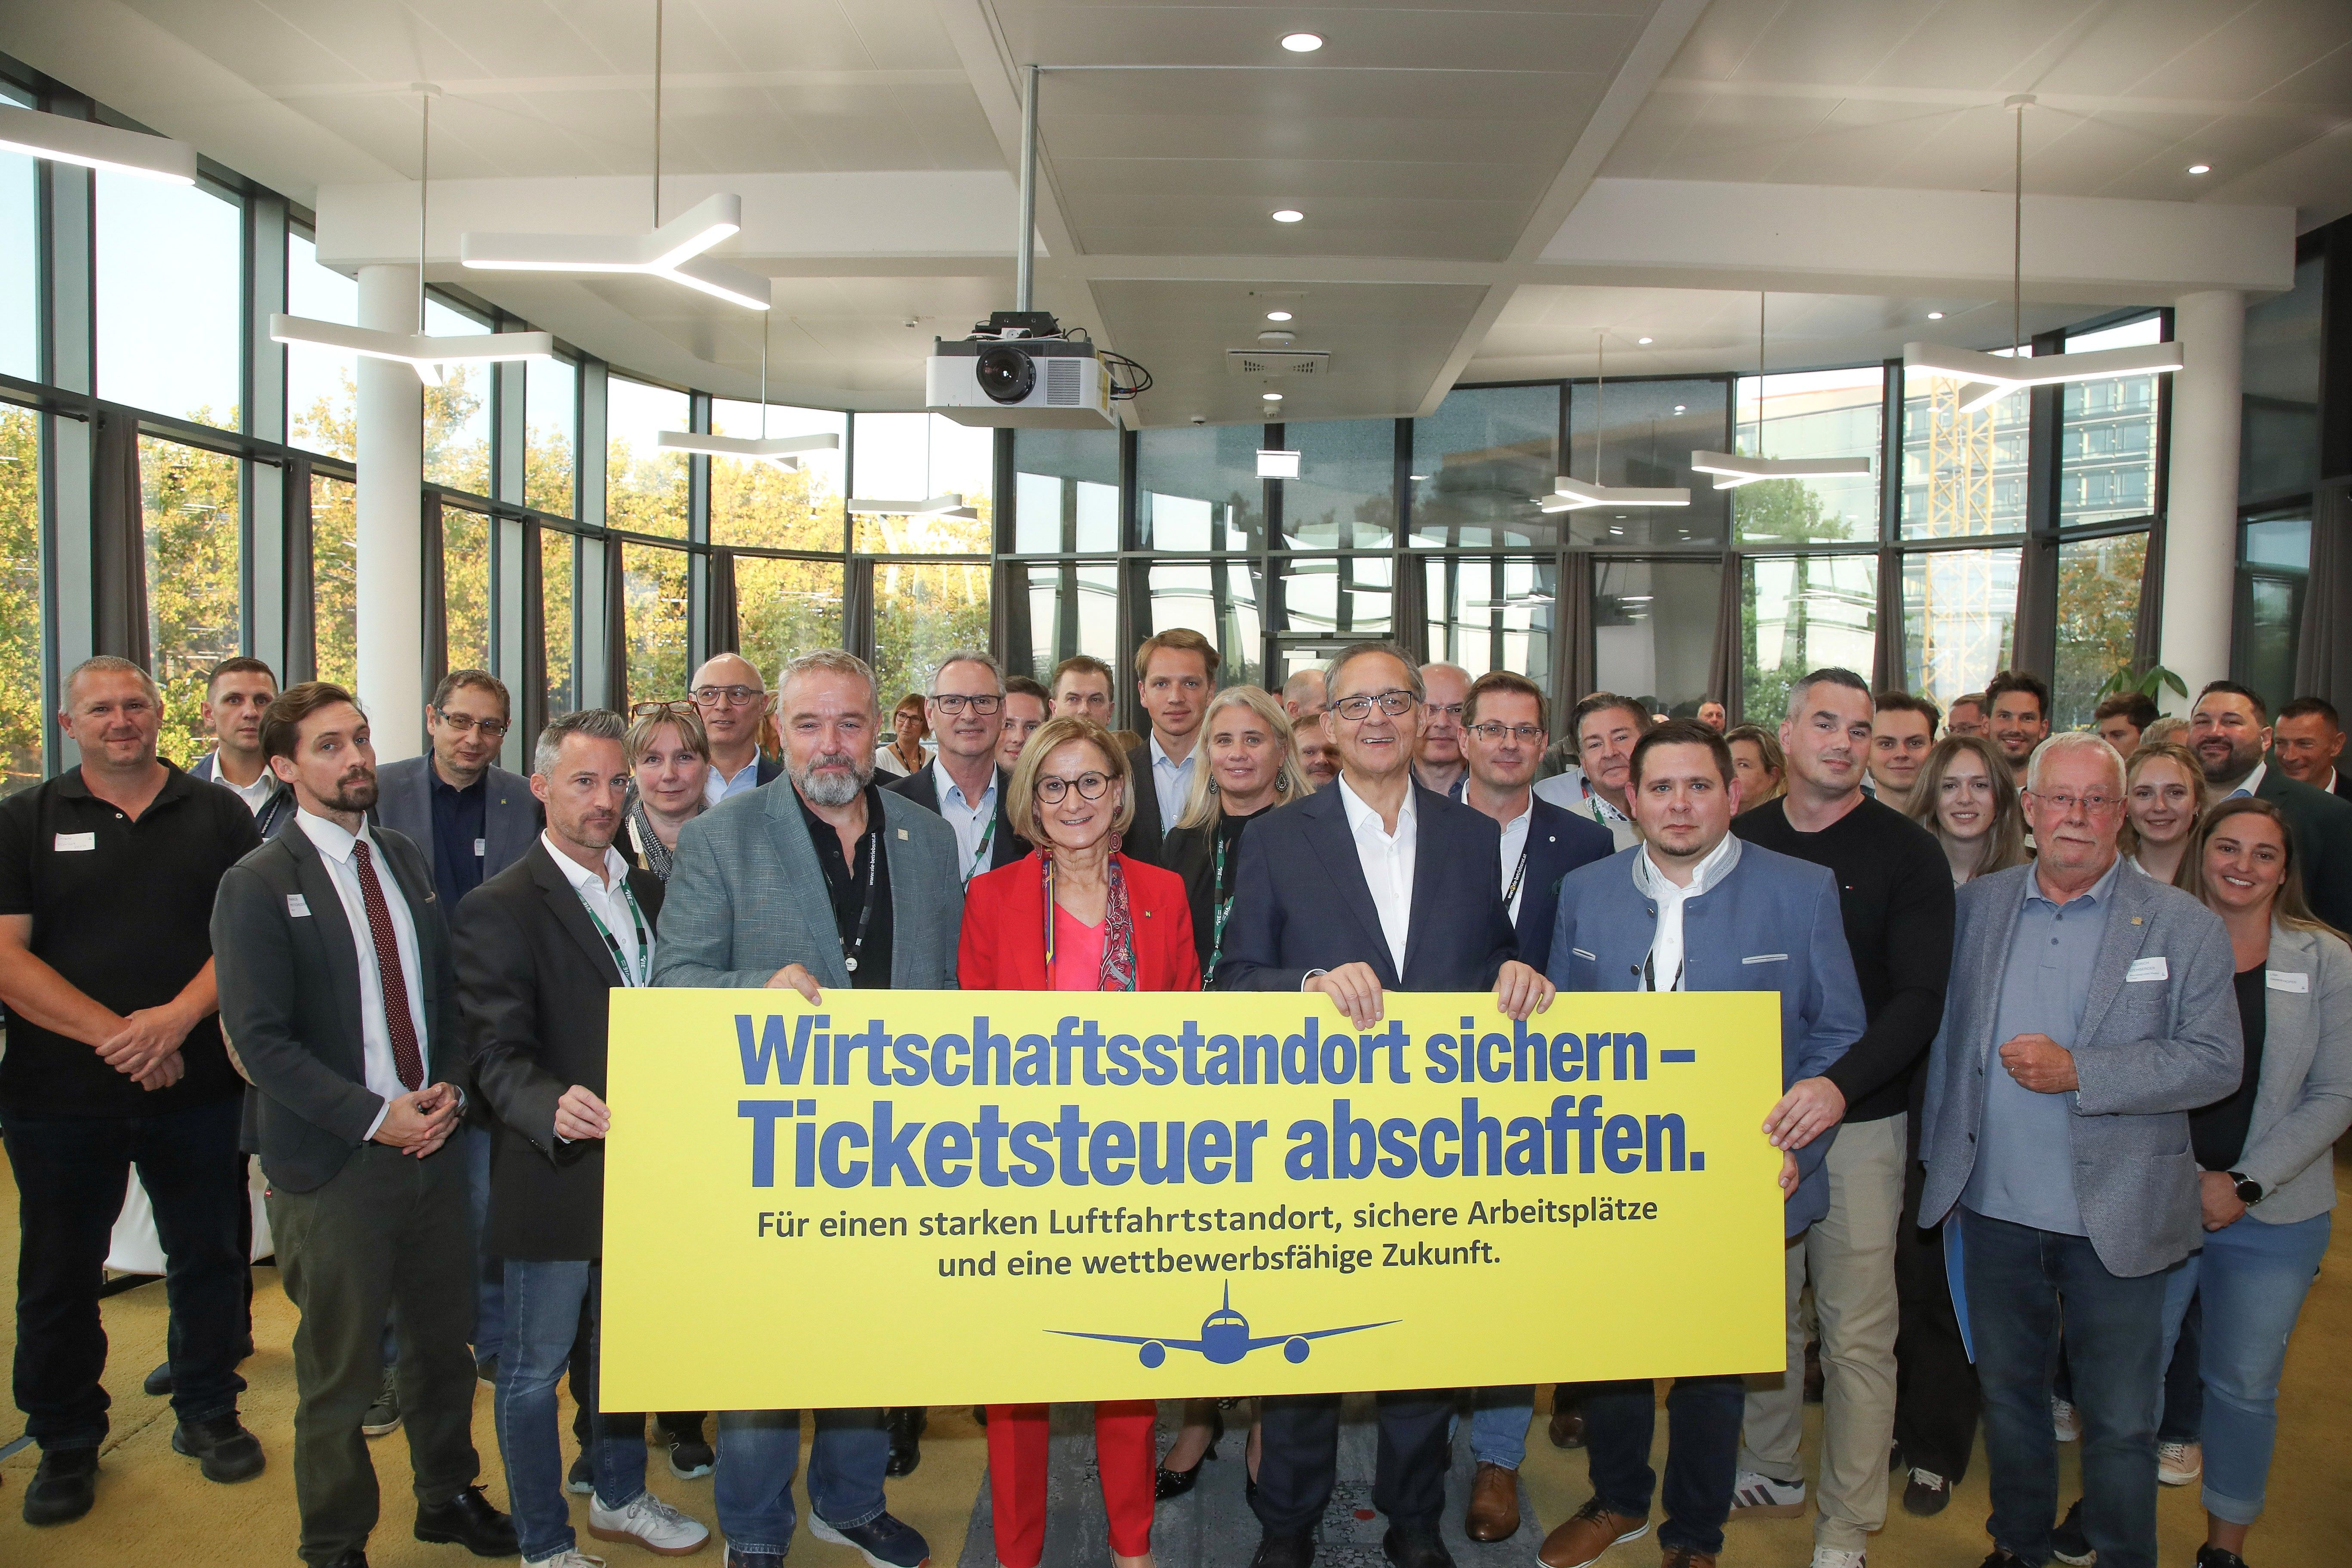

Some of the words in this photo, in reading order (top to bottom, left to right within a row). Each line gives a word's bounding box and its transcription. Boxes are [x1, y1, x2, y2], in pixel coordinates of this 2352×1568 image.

[582, 901, 591, 911] VIE
[625, 890, 633, 901] VIE
[735, 1015, 1410, 1086] Wirtschaftsstandort
[1425, 1016, 1647, 1083] sichern
[738, 1099, 1267, 1188] Ticketsteuer
[1285, 1094, 1704, 1181] abschaffen.
[759, 1211, 809, 1237] Für
[820, 1211, 906, 1237] einen
[920, 1209, 1037, 1236] starken
[1050, 1204, 1342, 1234] Luftfahrtstandort,
[1354, 1201, 1458, 1228] sichere
[1468, 1196, 1657, 1228] Arbeitsplätze
[939, 1250, 995, 1277] und
[1008, 1250, 1071, 1276] eine
[1082, 1244, 1372, 1274] wettbewerbsfähige
[1383, 1239, 1500, 1267] Zukunft.
